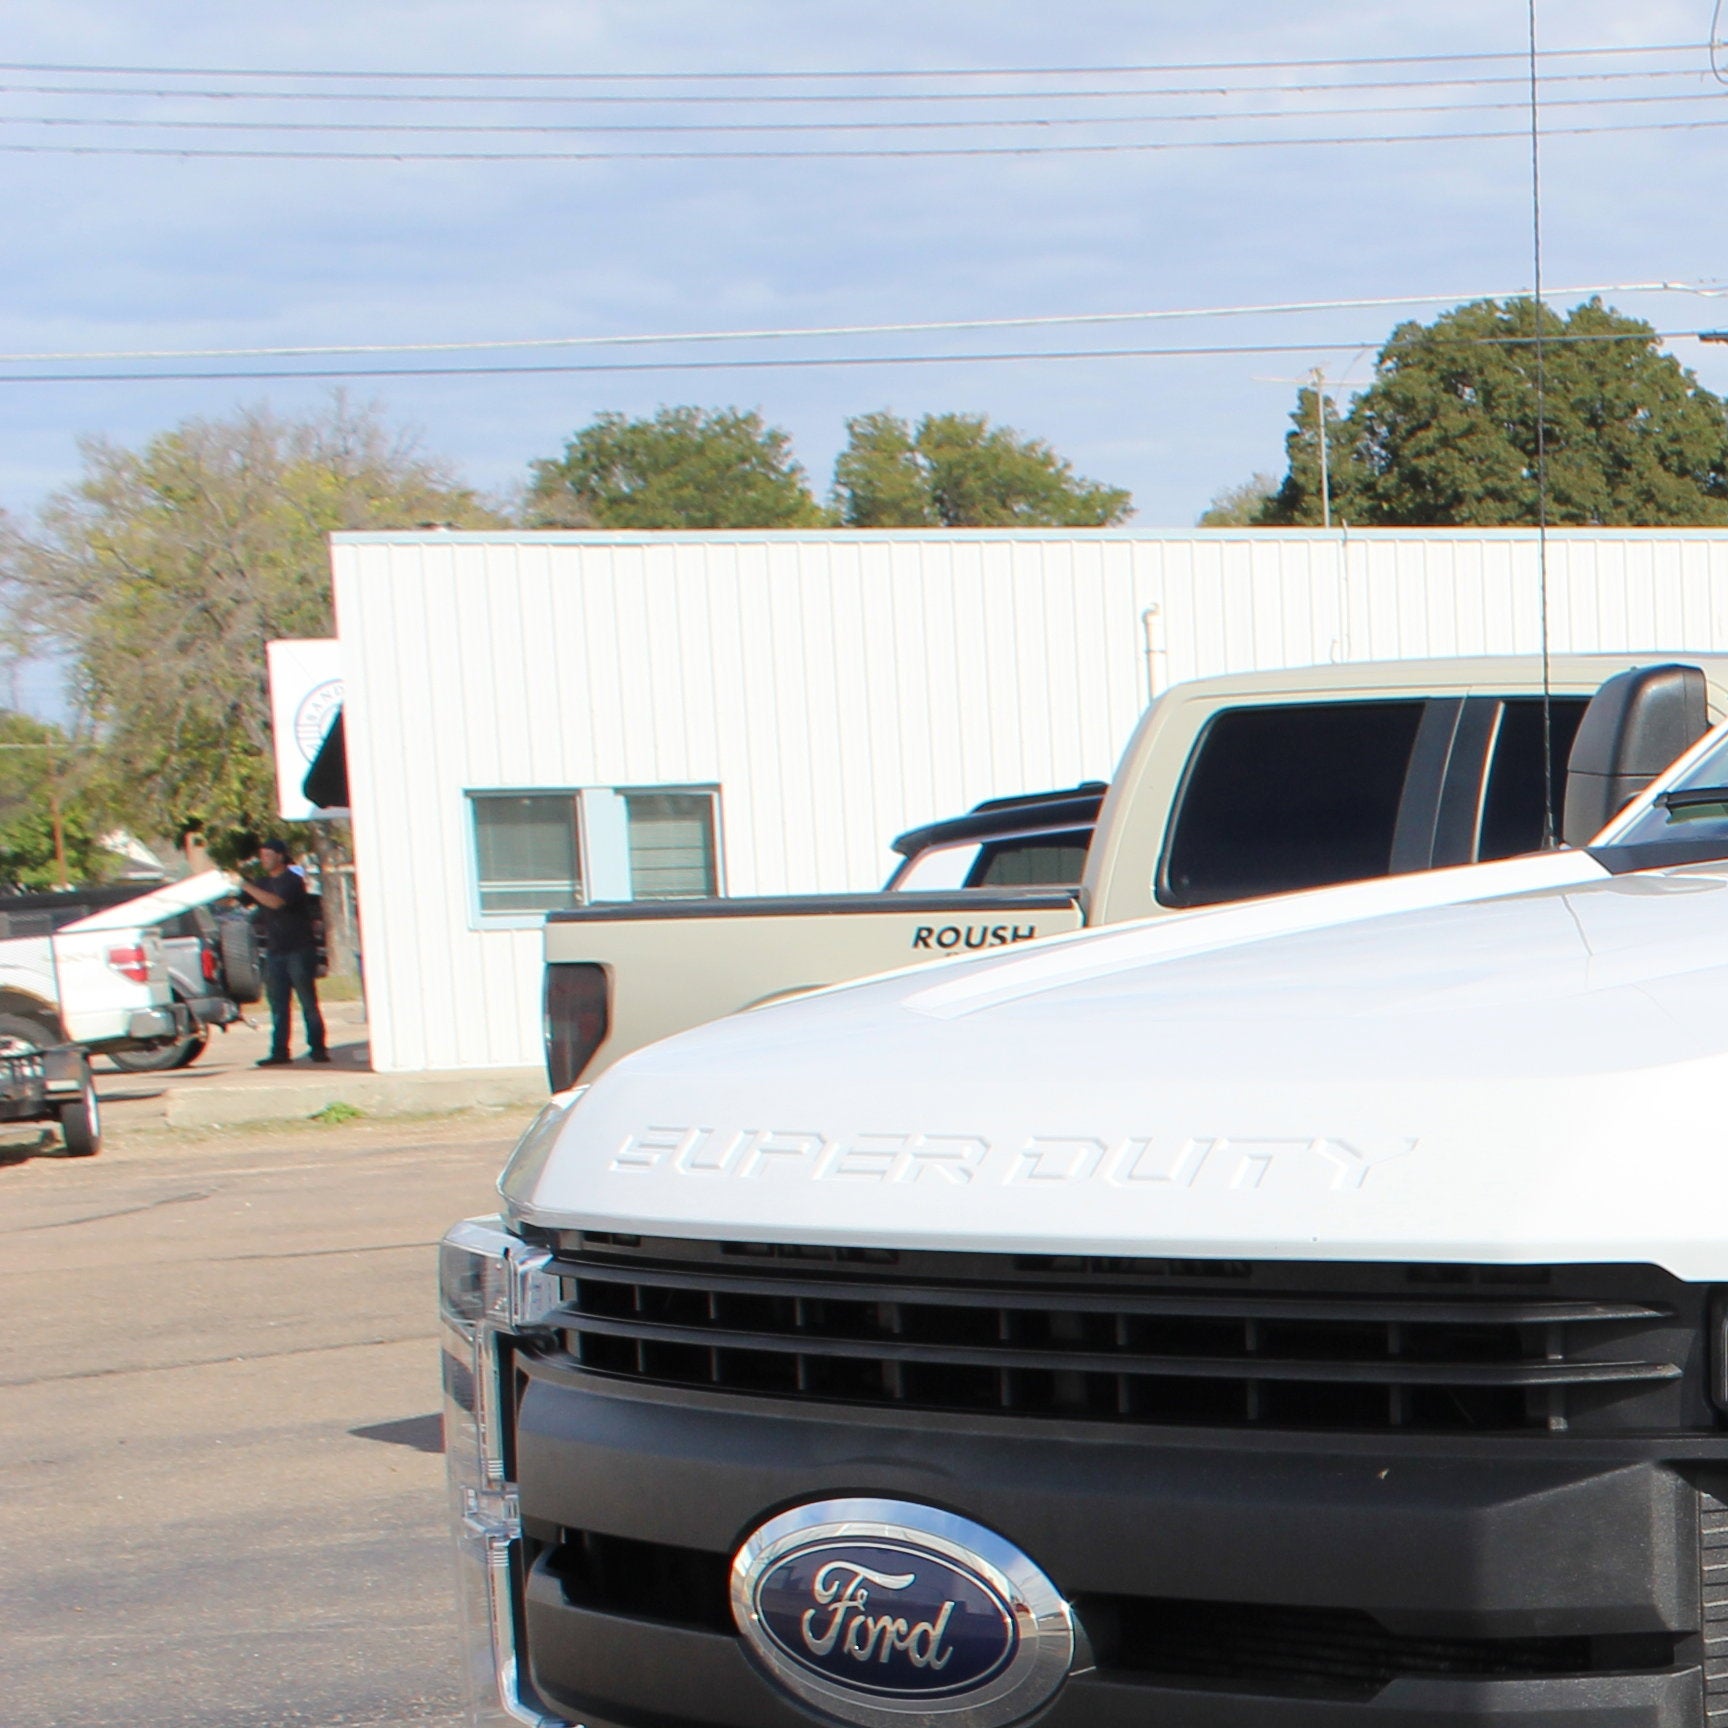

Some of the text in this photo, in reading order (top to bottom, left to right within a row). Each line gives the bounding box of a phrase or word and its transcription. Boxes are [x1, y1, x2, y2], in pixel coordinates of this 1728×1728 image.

[912, 925, 1036, 949] ROUSH
[609, 1126, 1421, 1189] SUPER DUTY
[803, 1560, 955, 1670] Ford
